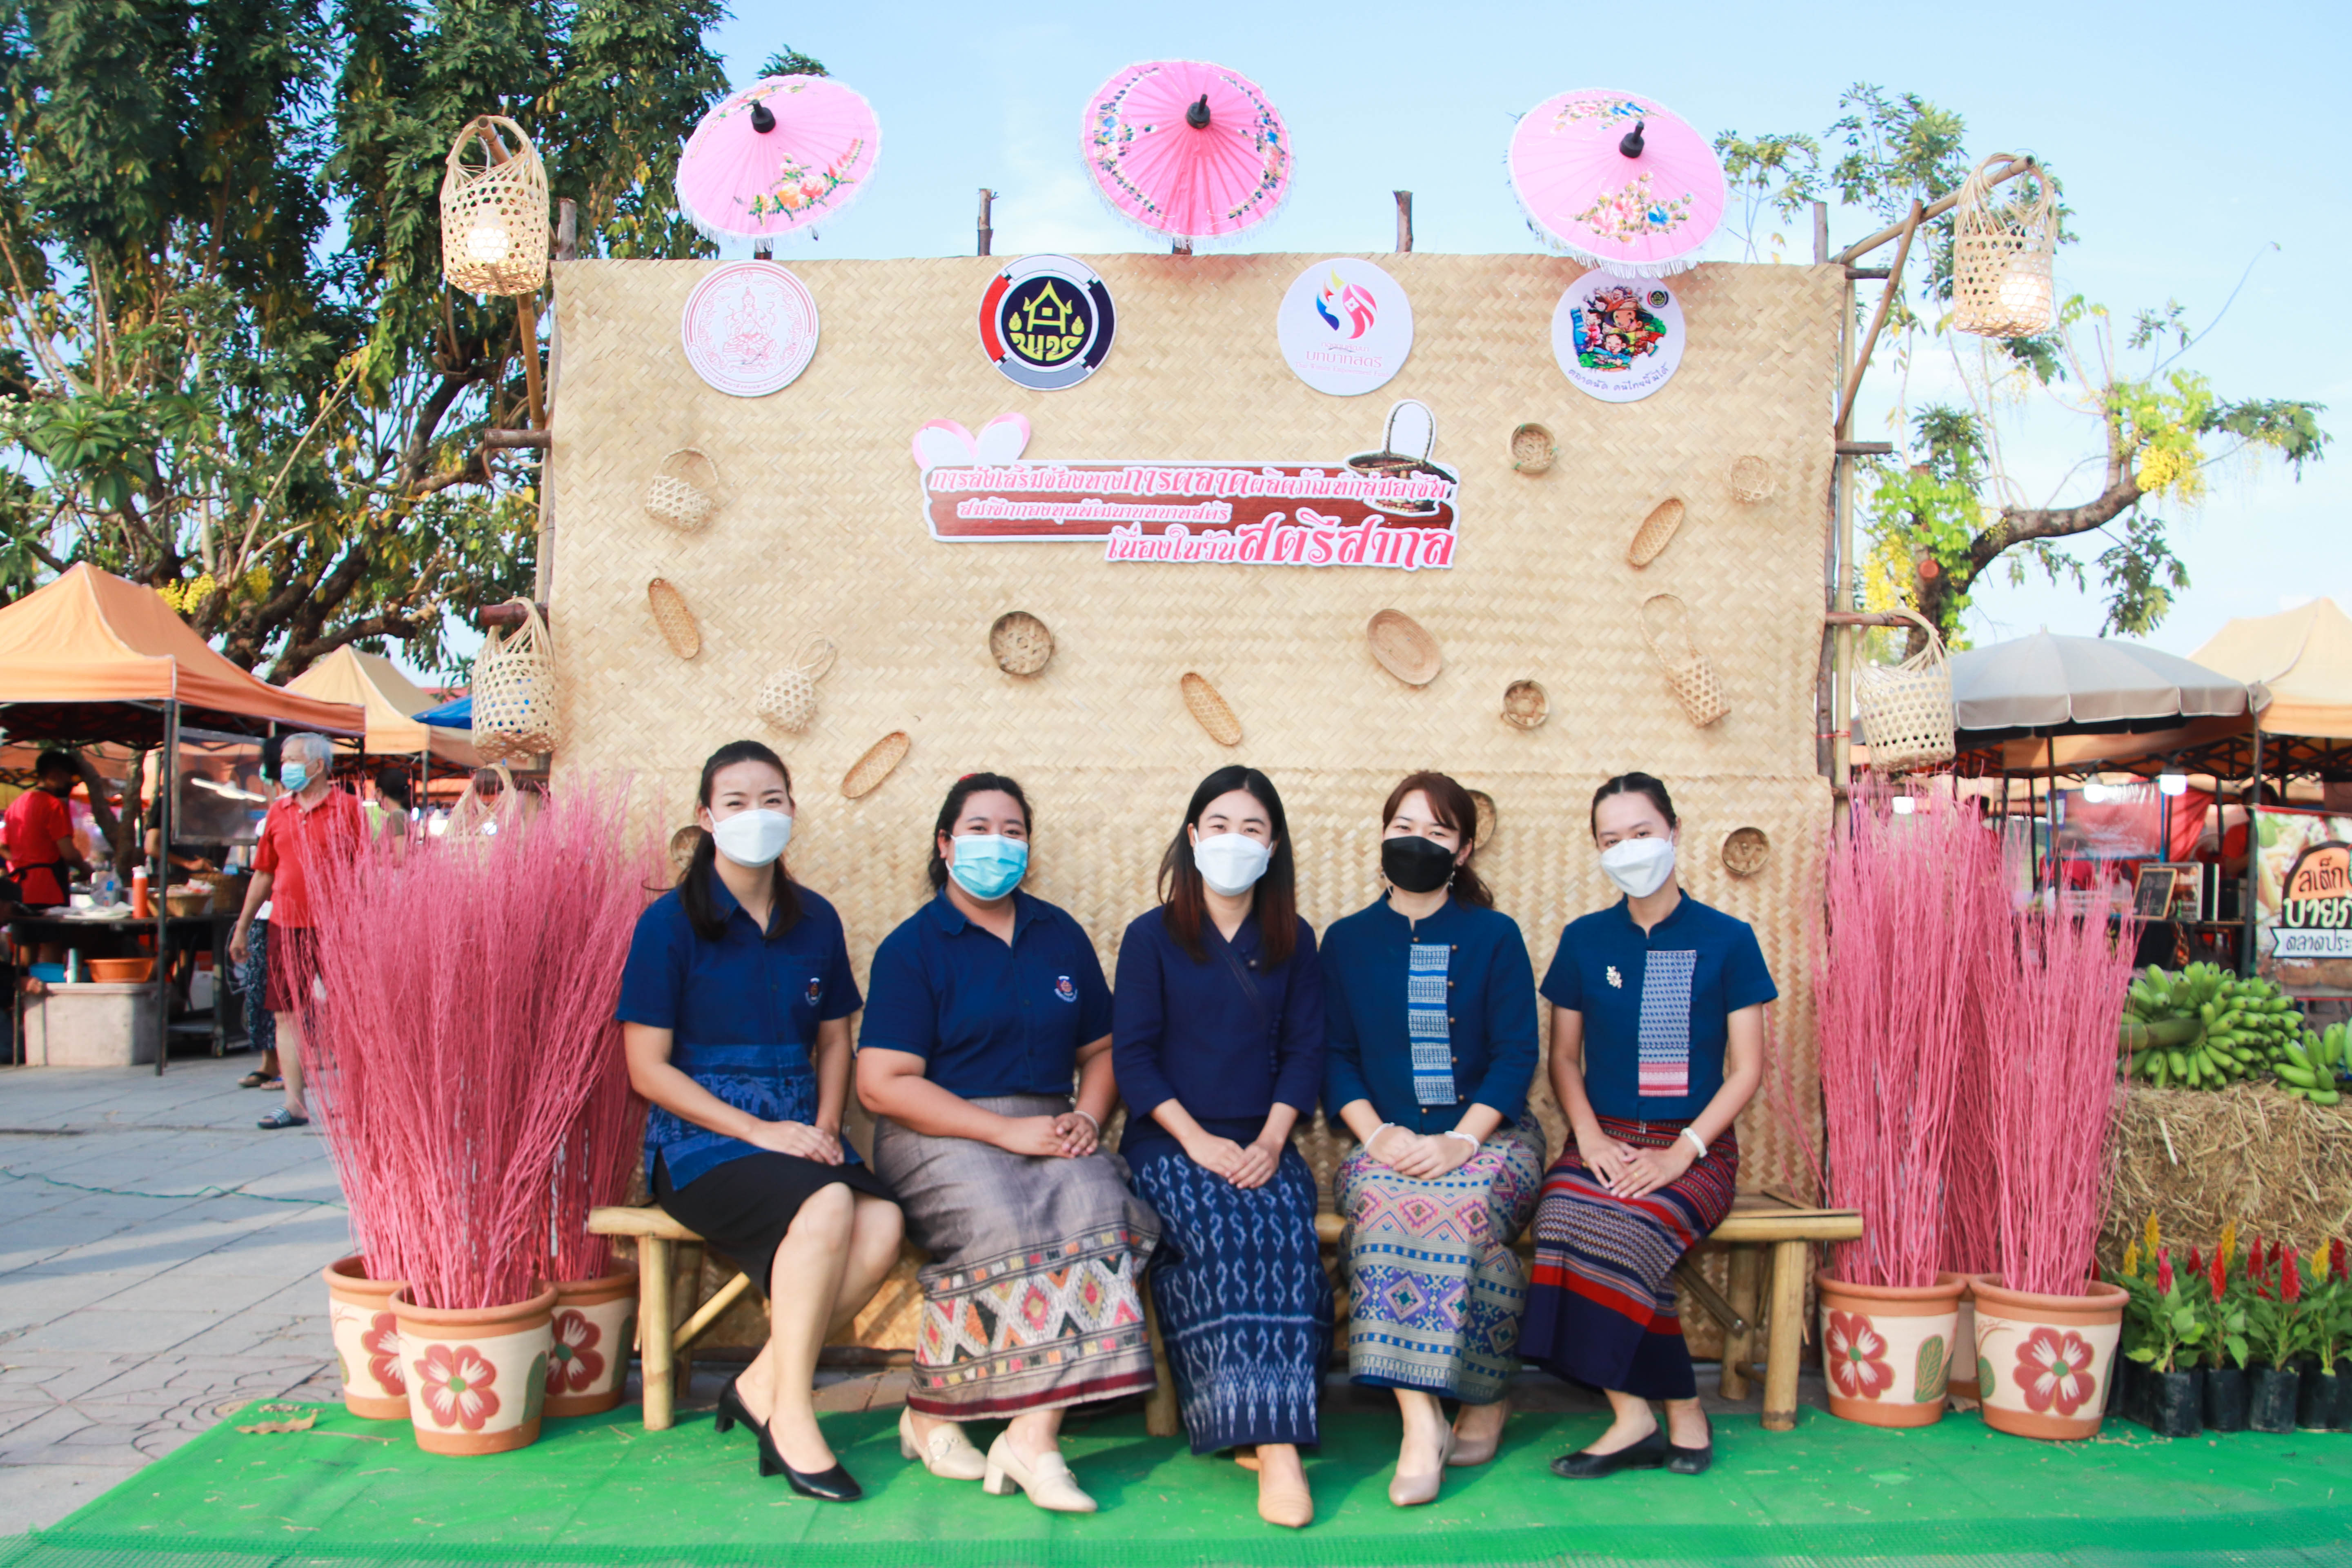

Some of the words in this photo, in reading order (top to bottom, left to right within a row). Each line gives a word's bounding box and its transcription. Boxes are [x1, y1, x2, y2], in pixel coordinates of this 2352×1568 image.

[1306, 351, 1382, 368] บทบาทสตรี
[960, 499, 1229, 520] สมาชิกกองทุนพัฒนาบทบาทสตรี
[1105, 512, 1454, 567] เนื่องในวันสตรีสากล
[2299, 855, 2343, 892] สเต็ก
